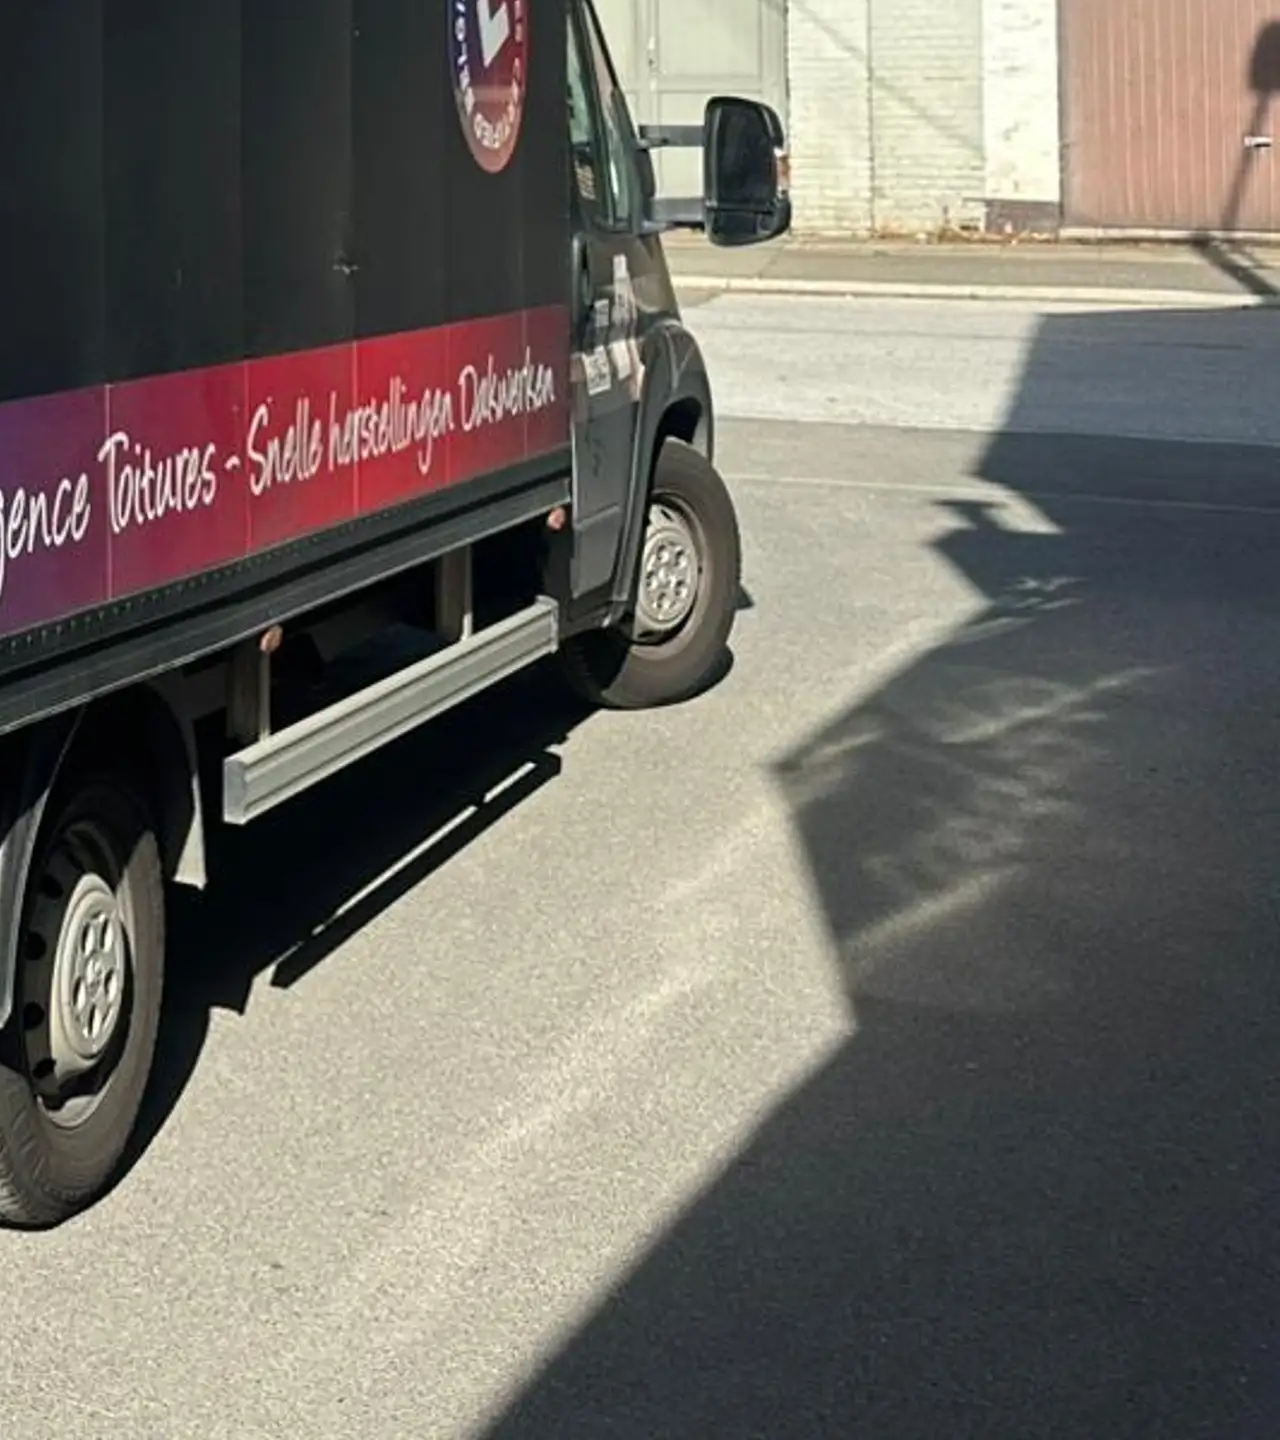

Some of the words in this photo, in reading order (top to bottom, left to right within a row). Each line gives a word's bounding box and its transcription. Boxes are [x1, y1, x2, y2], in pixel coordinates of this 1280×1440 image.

[97, 430, 217, 535] Toitures
[246, 405, 323, 496] Snelle
[329, 375, 455, 474] herstellingen
[458, 346, 556, 433] Dakwerken
